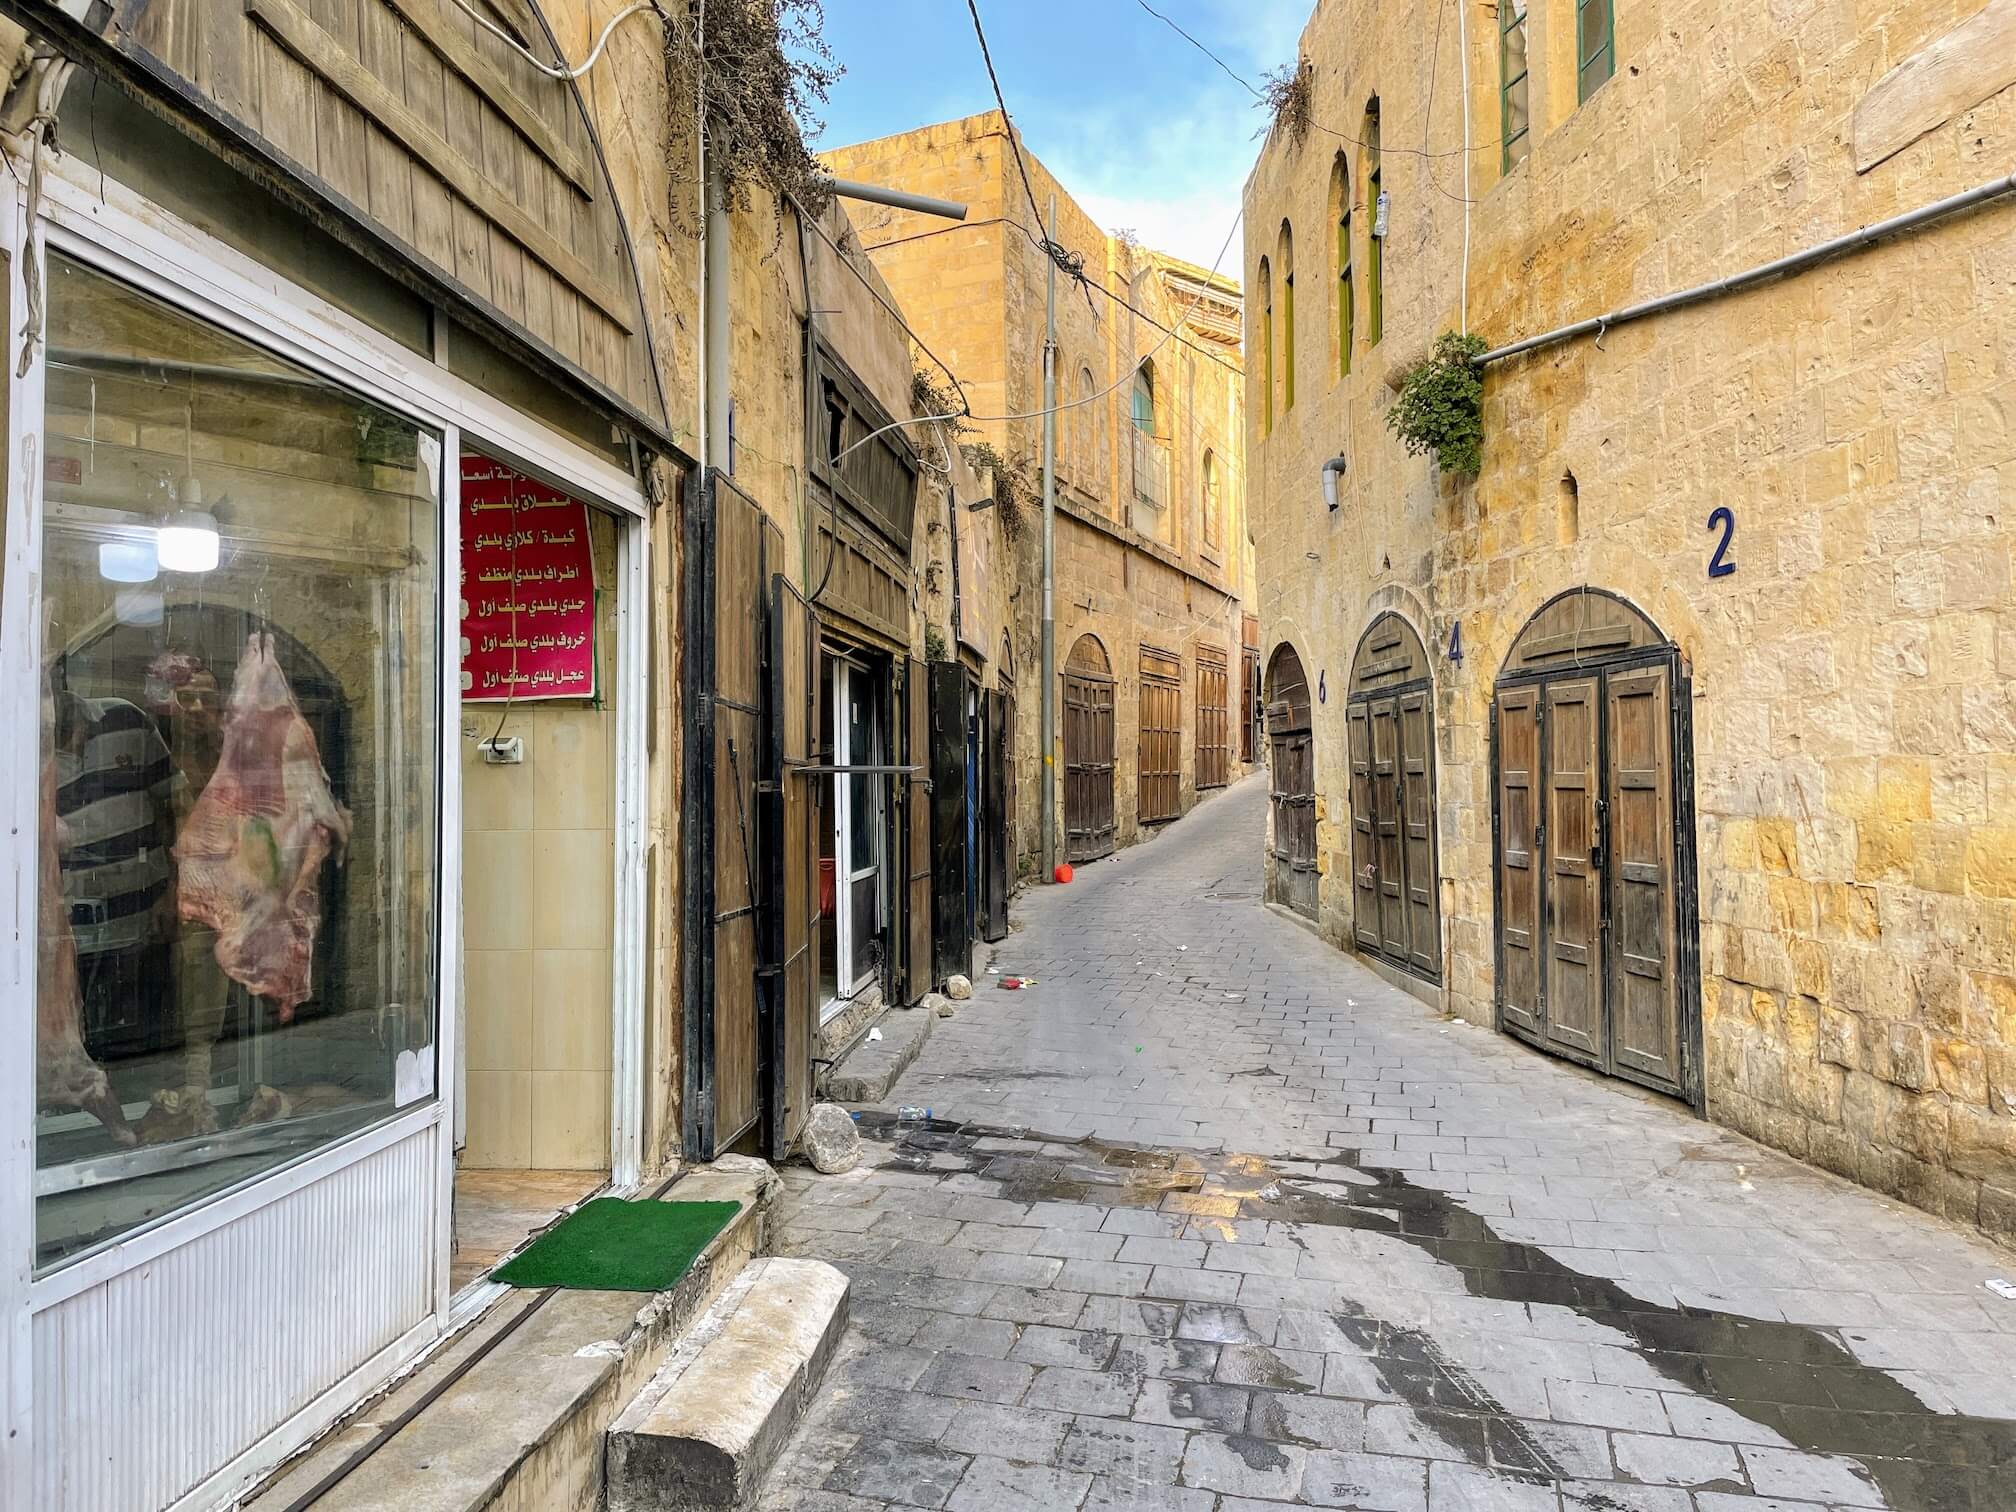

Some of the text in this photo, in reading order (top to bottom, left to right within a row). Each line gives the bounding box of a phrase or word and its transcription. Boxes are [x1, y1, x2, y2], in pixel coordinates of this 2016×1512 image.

[461, 466, 495, 481] أسعا
[470, 496, 519, 515] بلدي
[475, 532, 502, 552] بلدي
[542, 529, 575, 547] كبدة
[1707, 506, 1736, 578] 2
[478, 563, 579, 586] أطراف بلدي منظف
[478, 597, 495, 617] أول
[528, 598, 557, 617] بلدي
[559, 598, 586, 616] جدي
[480, 633, 497, 652] أول
[530, 634, 555, 652] بلدي
[556, 631, 586, 649] خروف
[1448, 621, 1464, 669] 4
[482, 668, 585, 688] عجل بلدي صنف أول
[1319, 669, 1326, 704] 6
